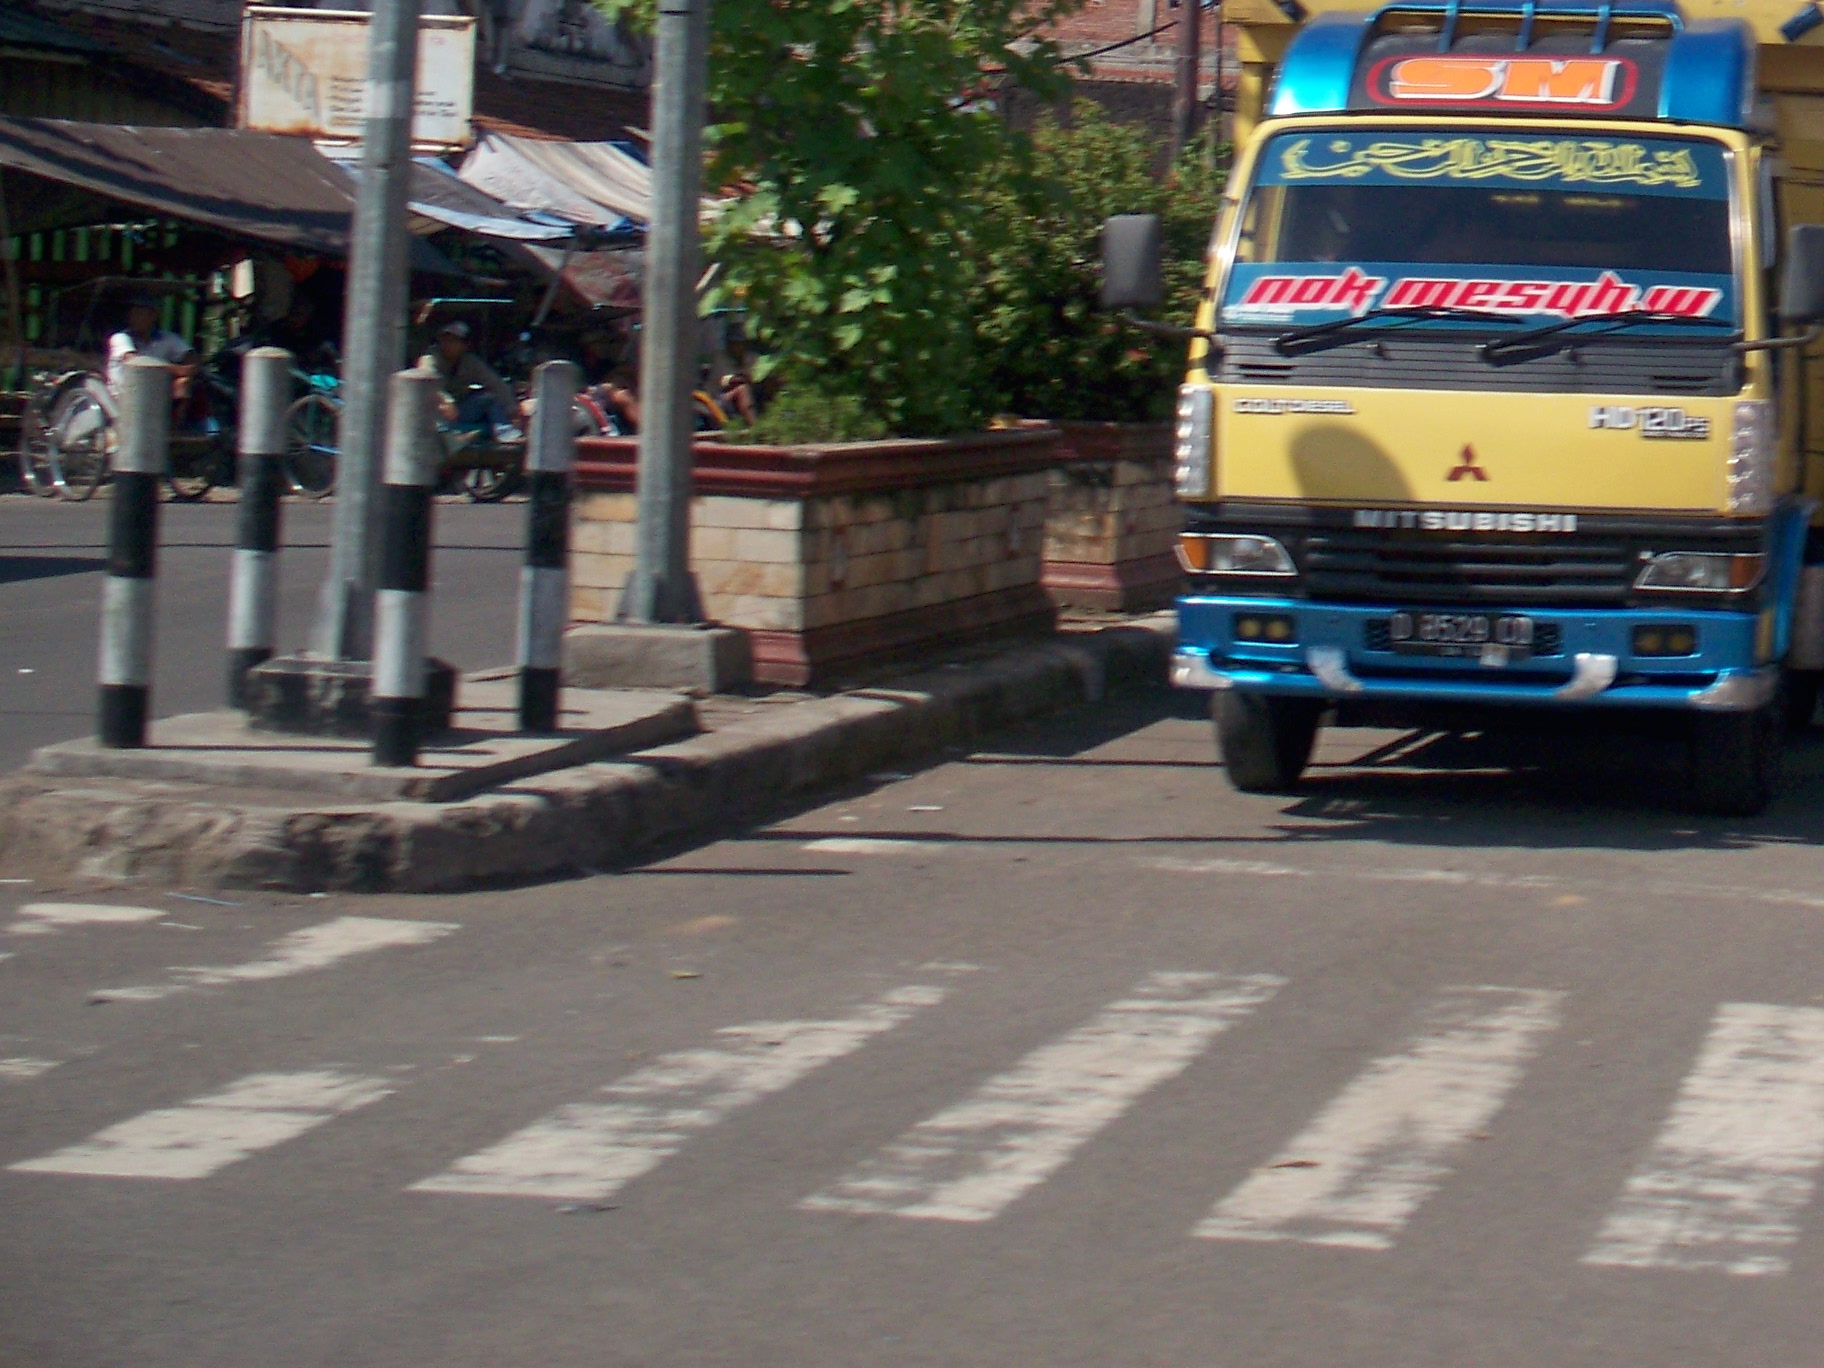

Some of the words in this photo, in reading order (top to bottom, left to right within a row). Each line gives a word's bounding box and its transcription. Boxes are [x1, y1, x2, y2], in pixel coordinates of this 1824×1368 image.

[1390, 59, 1620, 104] SM
[1589, 406, 1637, 429] HD
[1353, 509, 1578, 532] MITSUBISHI
